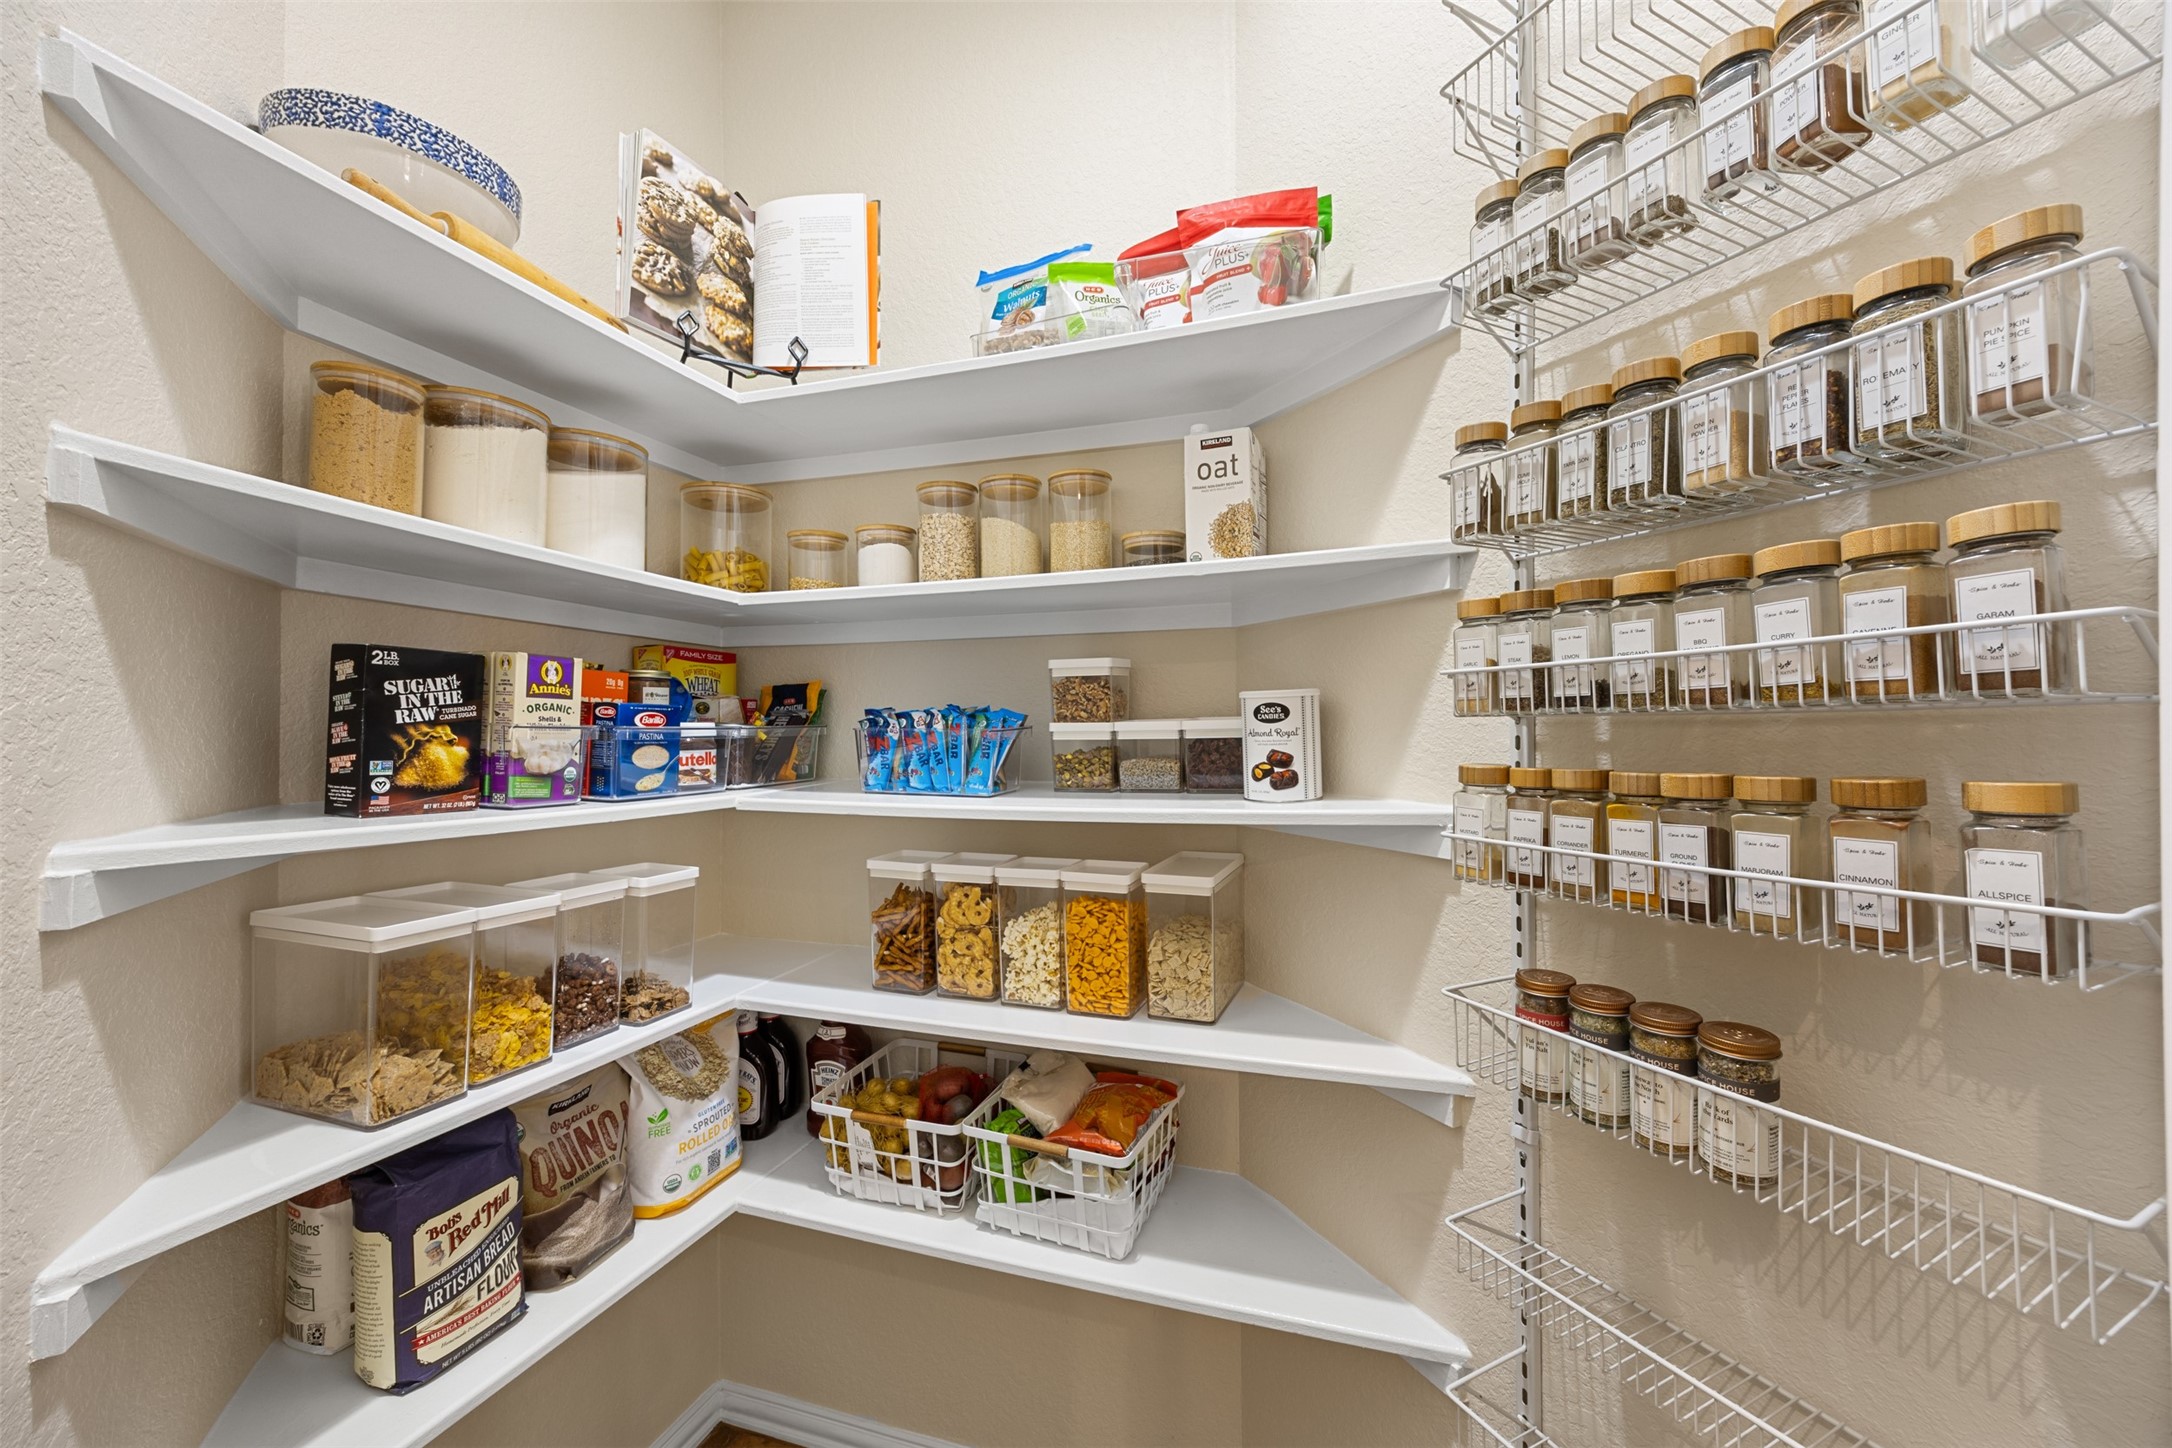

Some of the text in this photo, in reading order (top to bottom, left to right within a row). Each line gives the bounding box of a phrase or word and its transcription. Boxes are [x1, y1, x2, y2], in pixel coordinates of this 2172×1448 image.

[1202, 244, 1241, 275] Juice
[1003, 290, 1040, 313] Walnuts
[1075, 290, 1121, 305] Organics
[1984, 338, 1999, 348] PIE
[1862, 362, 1920, 386] ROEMAY
[1202, 437, 1232, 446] KIRKLAND
[1197, 453, 1239, 481] oat
[1976, 609, 2015, 620] GARAM
[1770, 632, 1796, 641] CURRY
[371, 649, 383, 665] 2
[680, 650, 723, 661] FAMILY SIZE
[694, 668, 708, 676] WHOLE
[708, 670, 721, 679] GRAIN
[383, 677, 450, 695] SUGAR
[529, 683, 571, 696] Annie's
[685, 676, 721, 693] WHEAT
[399, 690, 463, 709] IN THE
[394, 706, 438, 724] RAW
[441, 705, 477, 714] TURBINADO
[458, 711, 477, 719] SUGAR
[526, 703, 572, 715] ORGANIC
[1260, 705, 1282, 713] See's
[641, 716, 664, 724] Barilla
[638, 732, 664, 740] PASTINA
[1248, 727, 1299, 739] Almond Royal
[678, 751, 717, 766] utella
[1513, 836, 1537, 844] PAPRIKA
[1556, 840, 1588, 849] CORIANDER
[1614, 848, 1649, 858] TURMERIC
[1670, 853, 1697, 861] GROUND
[1741, 866, 1784, 877] MARJORAM
[1839, 873, 1893, 887] CINNAMON
[1978, 889, 2032, 903] ALLSPICE
[1538, 1018, 1565, 1027] HOUSE
[1580, 1032, 1609, 1045] HOUSE
[1648, 1058, 1680, 1070] HOUSE
[821, 1067, 839, 1075] HEINZ
[1720, 1082, 1755, 1096] HOUSE
[551, 1086, 590, 1110] KIRKLAND
[697, 1098, 725, 1117] GLUTEN FREE
[1721, 1108, 1730, 1116] of
[550, 1102, 599, 1135] Organic
[693, 1103, 731, 1133] SPROUTED
[648, 1126, 671, 1139] FREE
[678, 1124, 720, 1155] ROLLED
[560, 1182, 574, 1193] FROM
[574, 1171, 590, 1184] ANDEAN
[589, 1159, 609, 1176] FARMERS
[425, 1212, 462, 1242] Bob's
[447, 1184, 510, 1258] Red Mill
[423, 1260, 482, 1315] ARTISAN
[483, 1221, 515, 1268] BREAD
[427, 1248, 482, 1293] UNBLEACHED
[476, 1246, 518, 1302] FLOUR
[425, 1281, 517, 1343] AMERICA'S BEST BAKING FLOUR
[442, 1360, 452, 1369] NET
